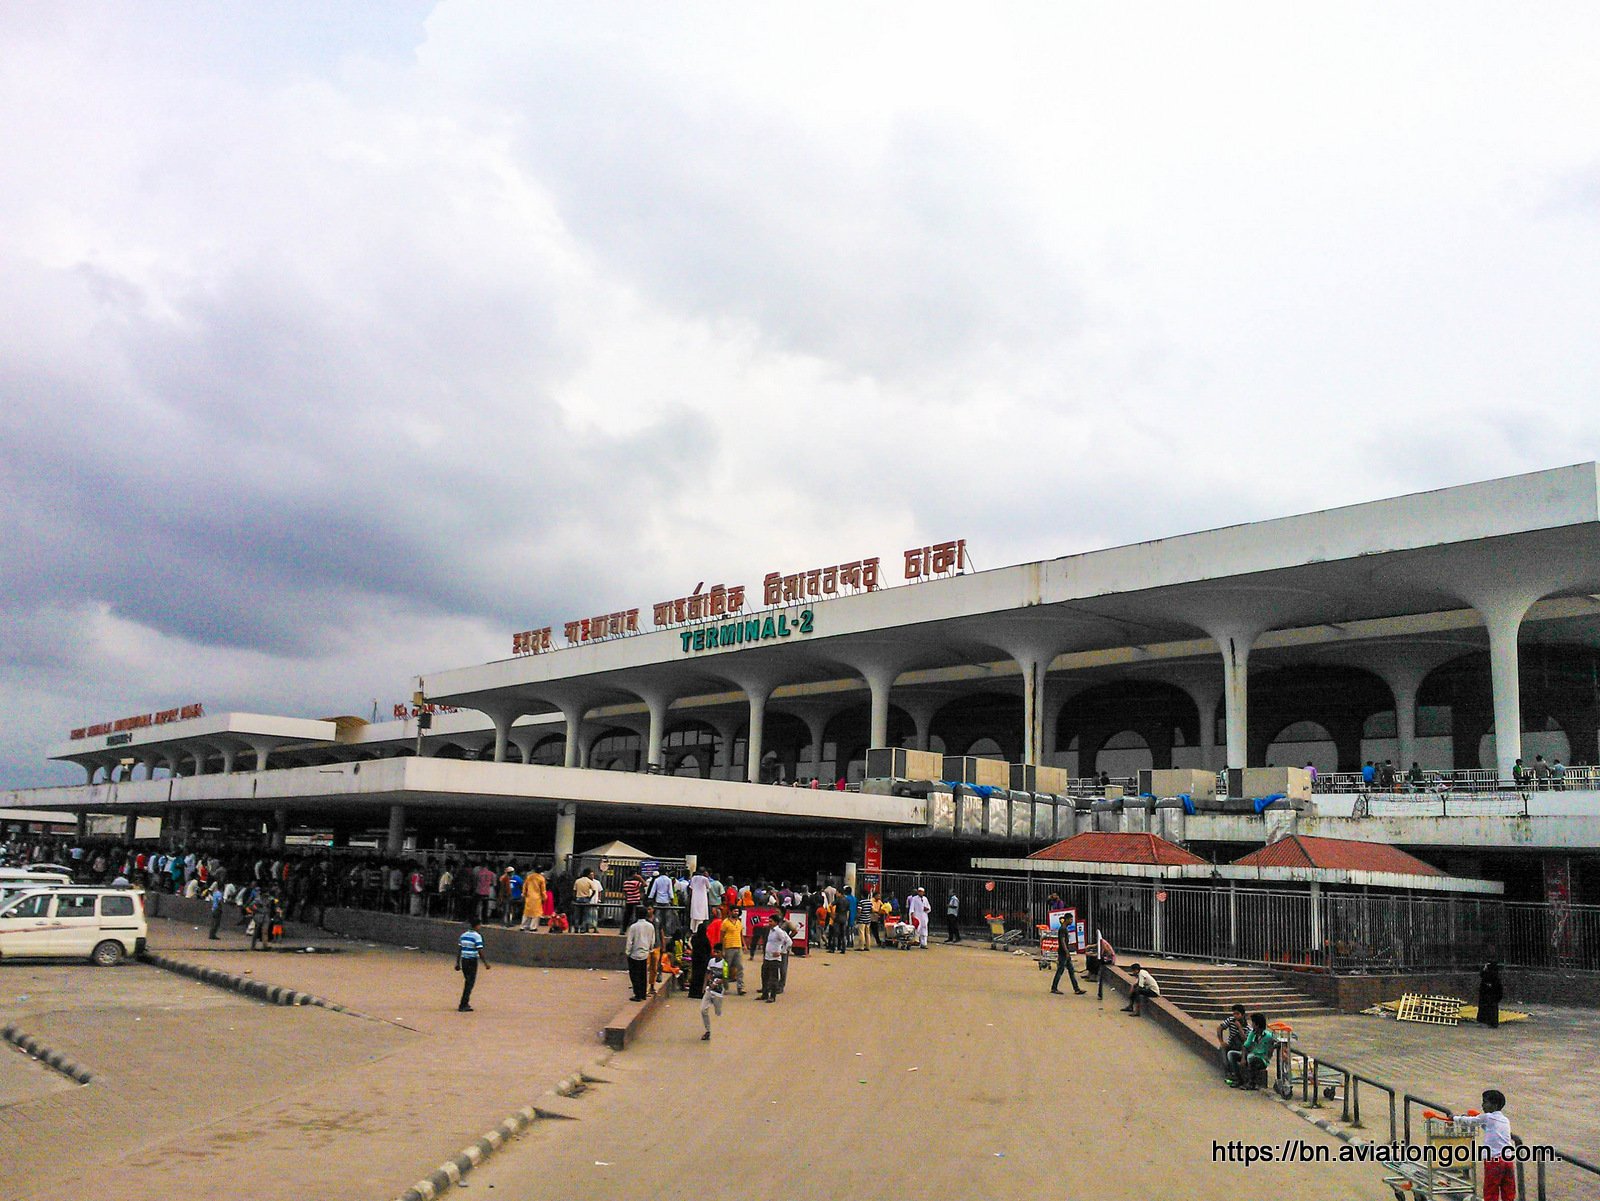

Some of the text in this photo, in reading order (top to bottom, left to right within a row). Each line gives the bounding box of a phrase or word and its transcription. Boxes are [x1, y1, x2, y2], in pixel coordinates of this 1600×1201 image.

[763, 556, 880, 606] বিমানবন্দর
[904, 538, 966, 580] ঢাকা
[680, 610, 814, 652] TERMINAL-2
